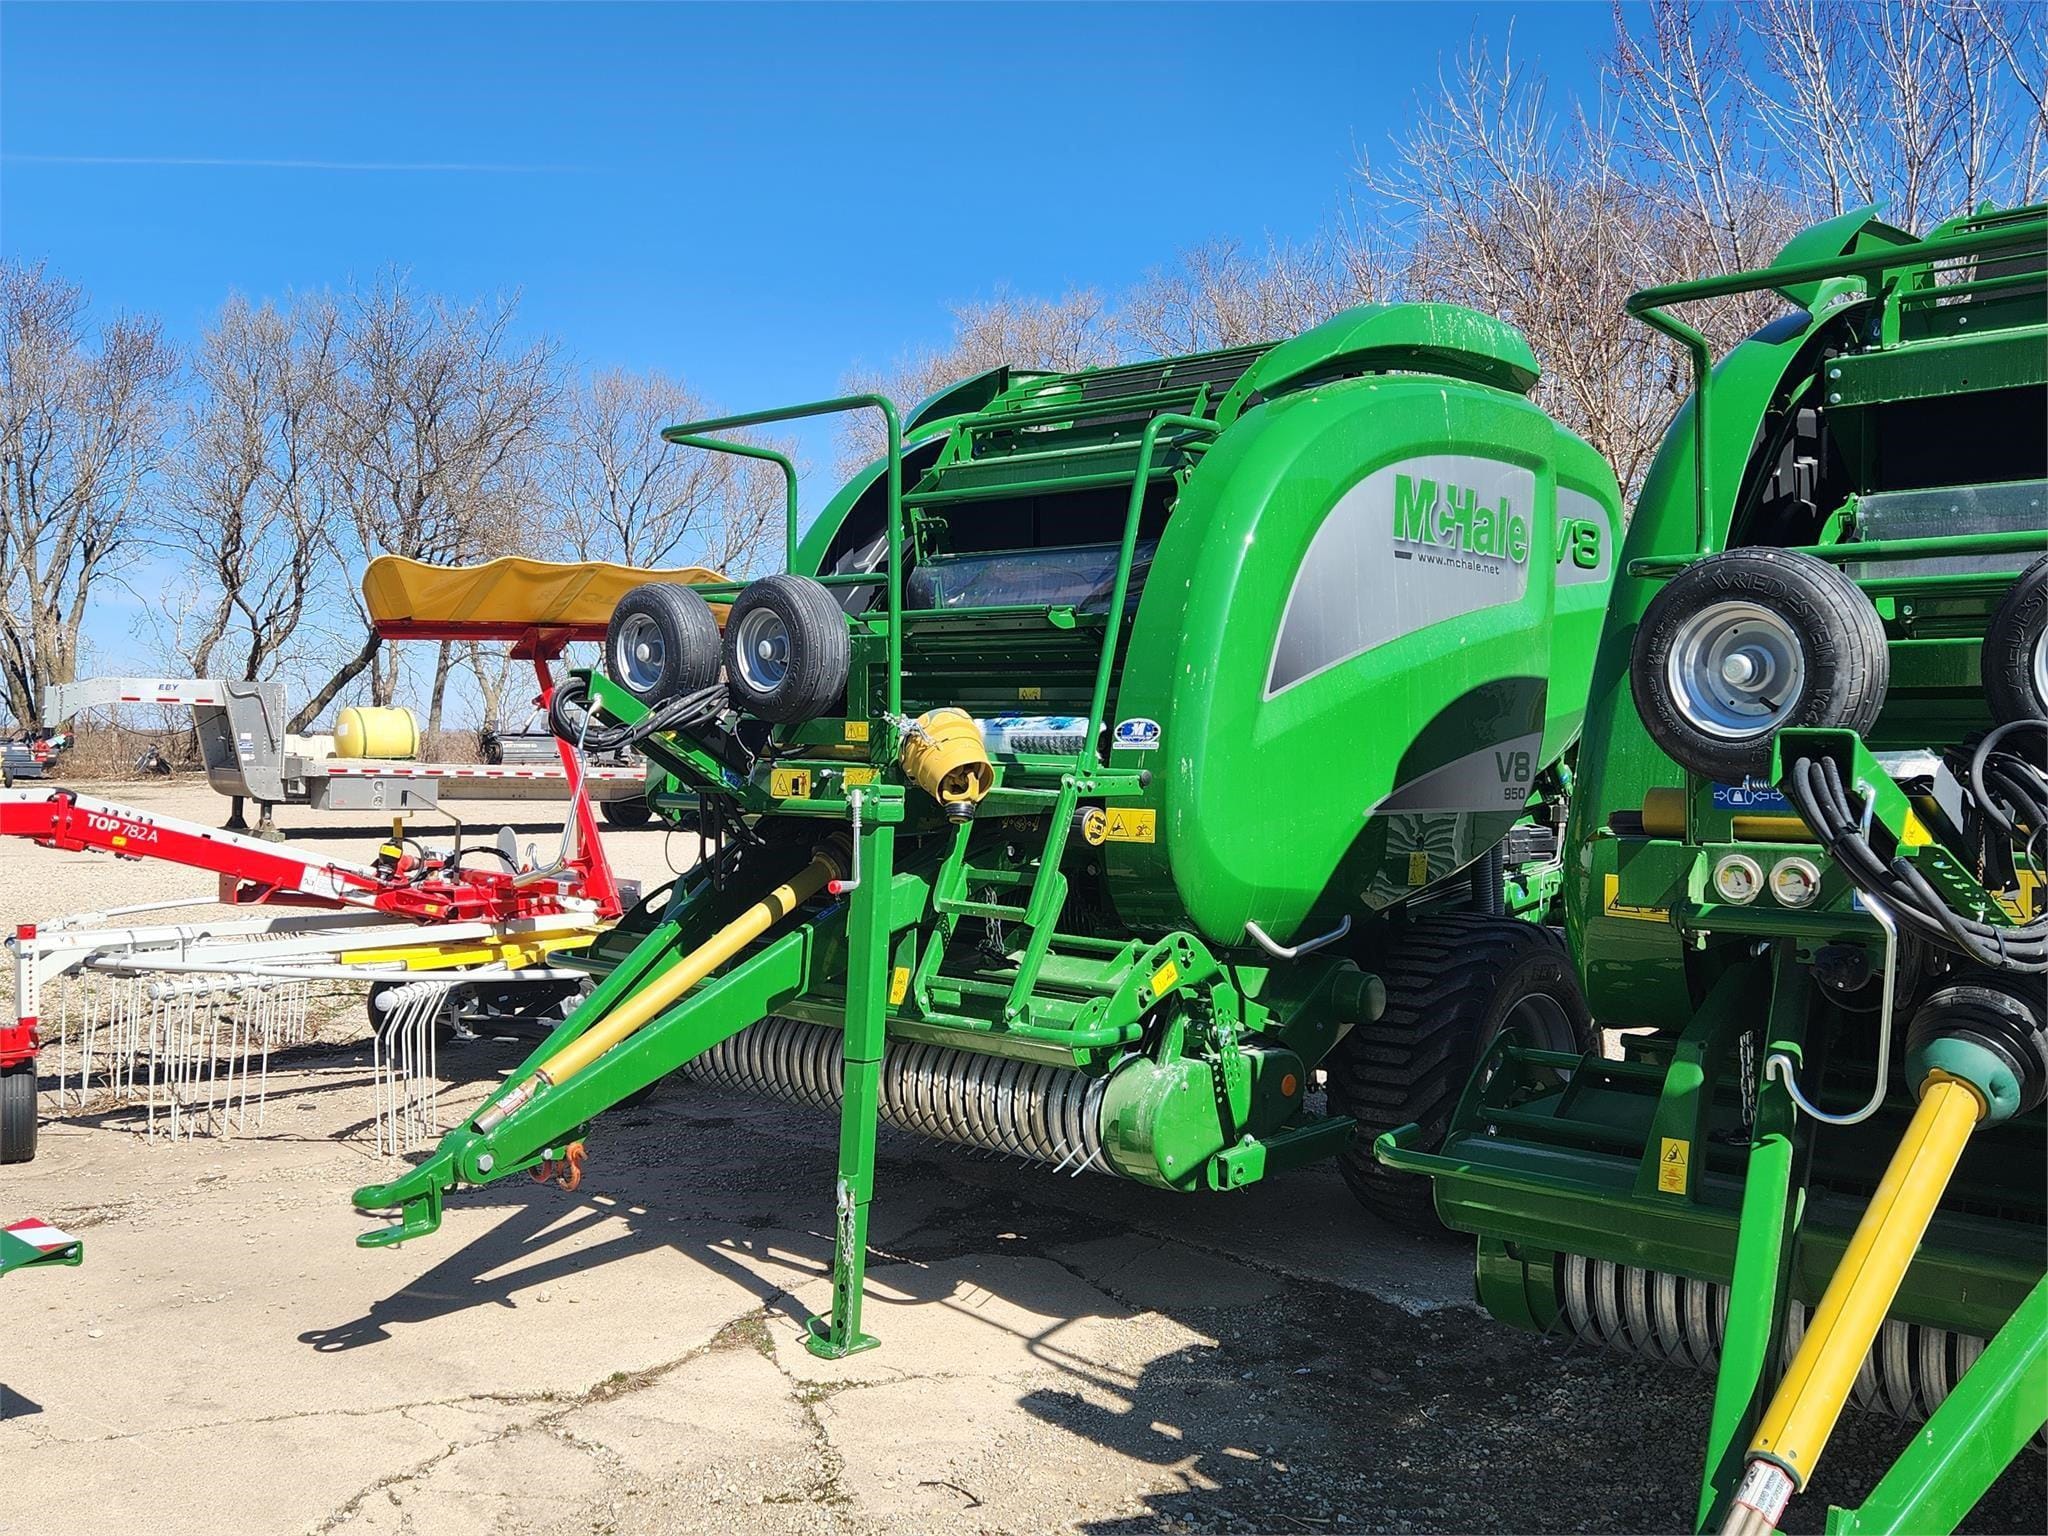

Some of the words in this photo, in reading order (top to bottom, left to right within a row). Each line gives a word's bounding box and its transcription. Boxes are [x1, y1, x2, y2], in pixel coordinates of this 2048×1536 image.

[1392, 473, 1528, 563] McHale
[1418, 552, 1499, 575] www.mchale.net
[158, 683, 179, 691] EBY
[1495, 752, 1529, 782] V8
[1504, 788, 1525, 800] 950
[87, 813, 120, 832] TOP
